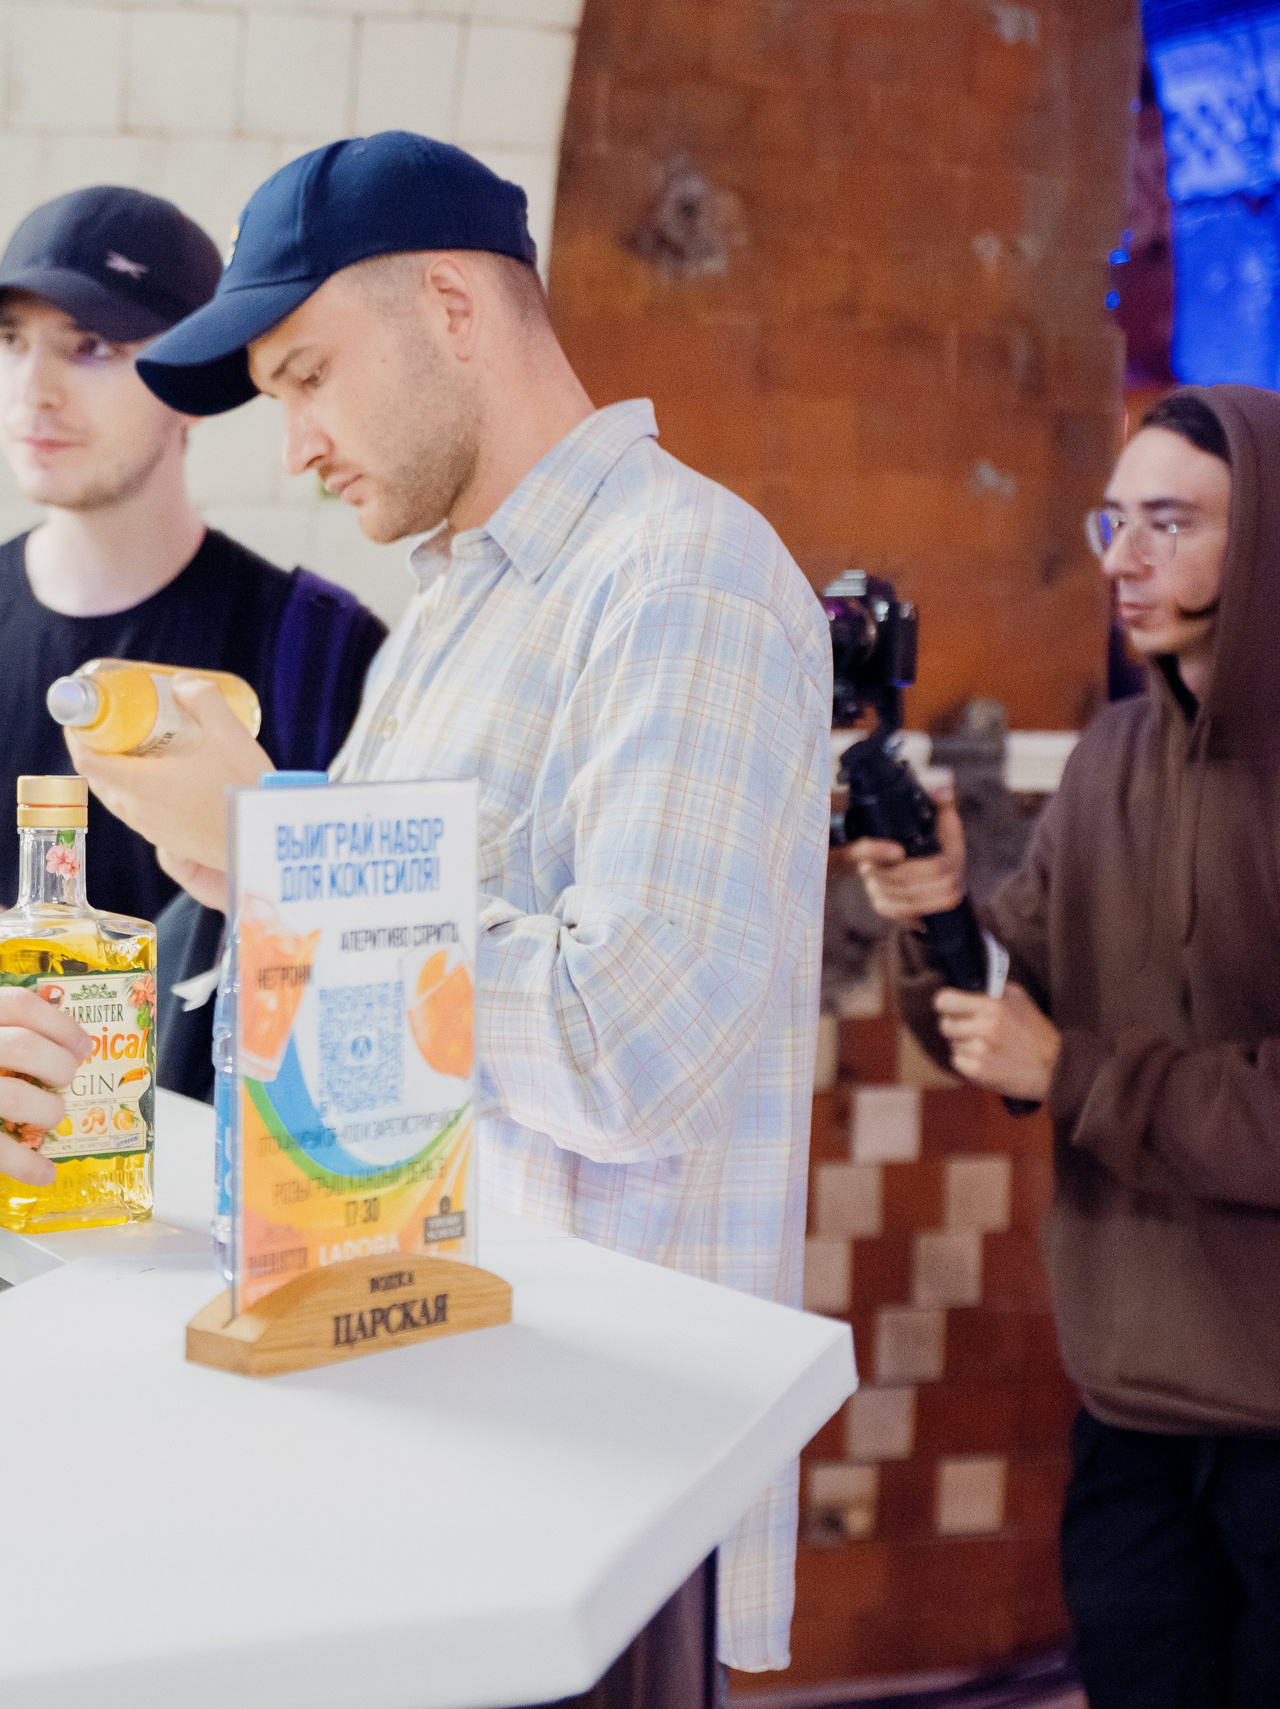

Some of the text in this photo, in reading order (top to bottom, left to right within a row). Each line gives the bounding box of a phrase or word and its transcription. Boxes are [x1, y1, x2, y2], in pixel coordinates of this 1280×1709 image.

[277, 813, 445, 861] ВЫИГРАЙ НАБОР
[281, 864, 324, 903] ДЛЯ
[71, 1073, 115, 1097] GIN
[319, 1233, 399, 1267] LADOGA
[333, 1293, 449, 1348] ЦАРСКАЯ
